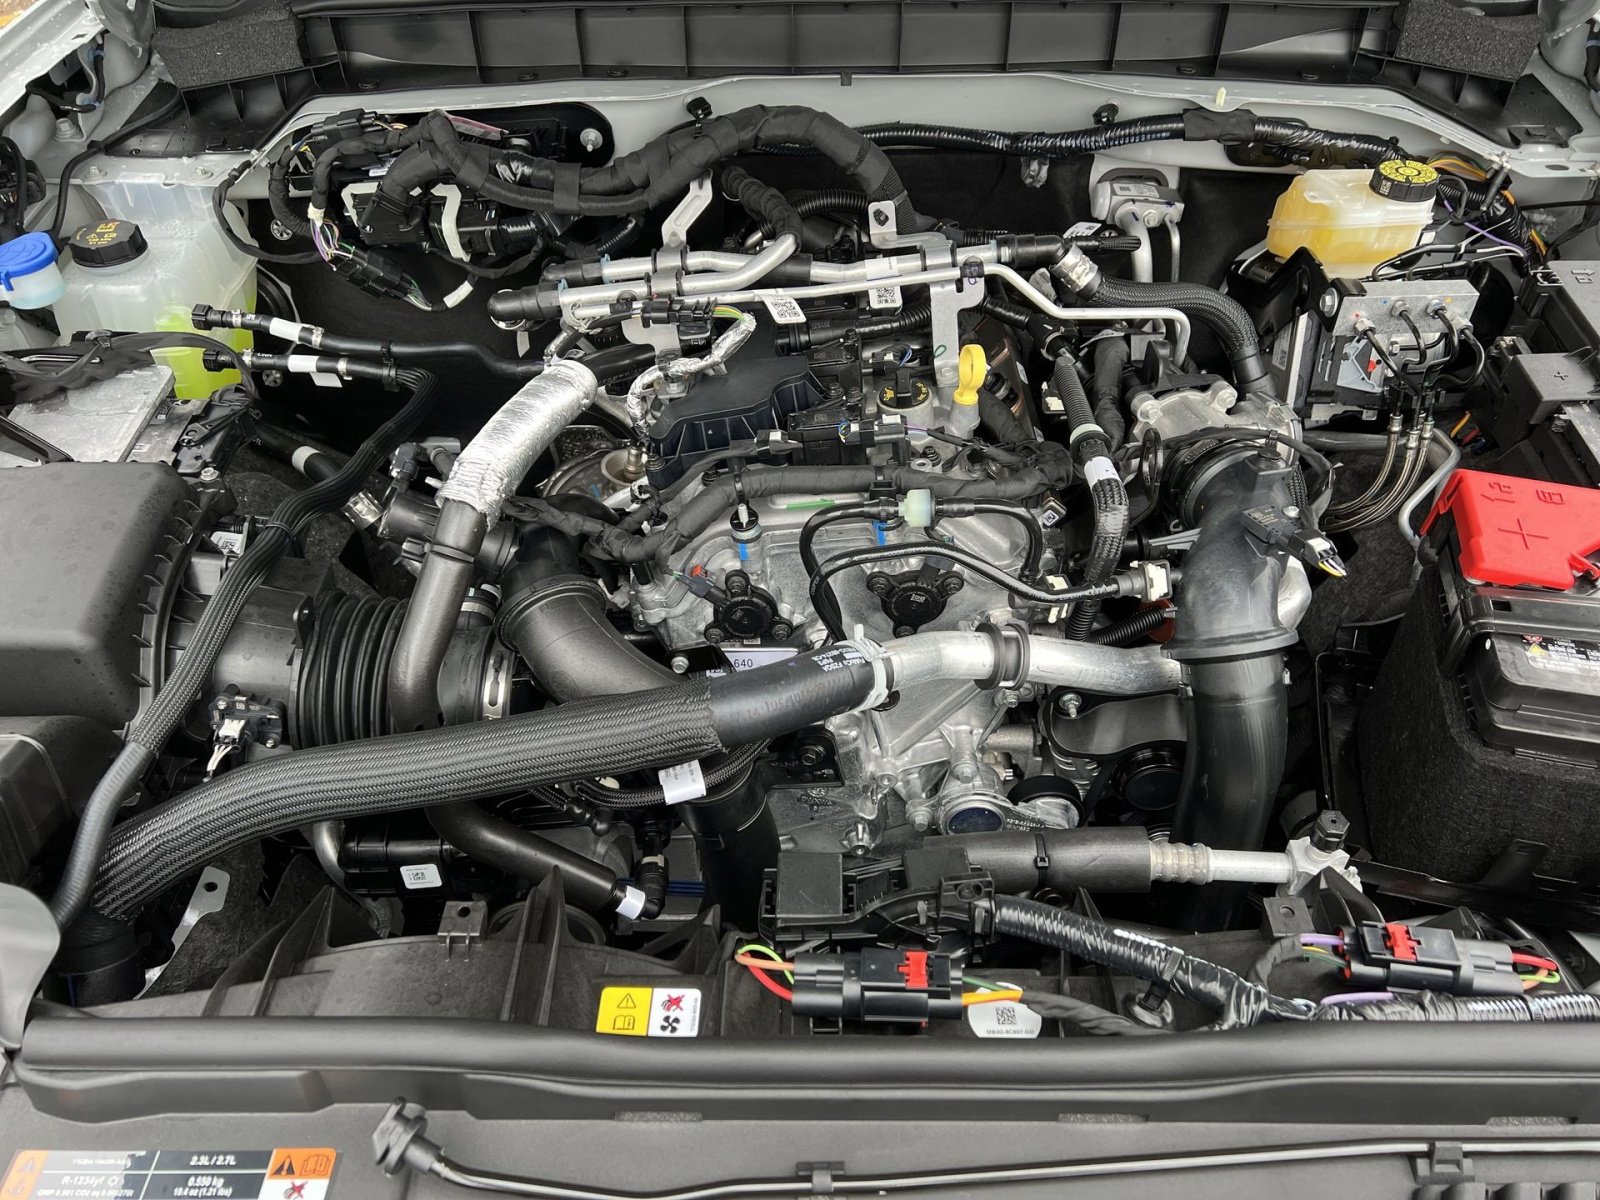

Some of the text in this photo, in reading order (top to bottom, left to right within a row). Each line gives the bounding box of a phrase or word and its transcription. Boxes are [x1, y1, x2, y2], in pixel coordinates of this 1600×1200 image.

[733, 658, 753, 668] 640
[189, 1154, 210, 1166] 2.3L
[215, 1154, 237, 1166] 2.7L
[61, 1175, 105, 1187] R-1234yf
